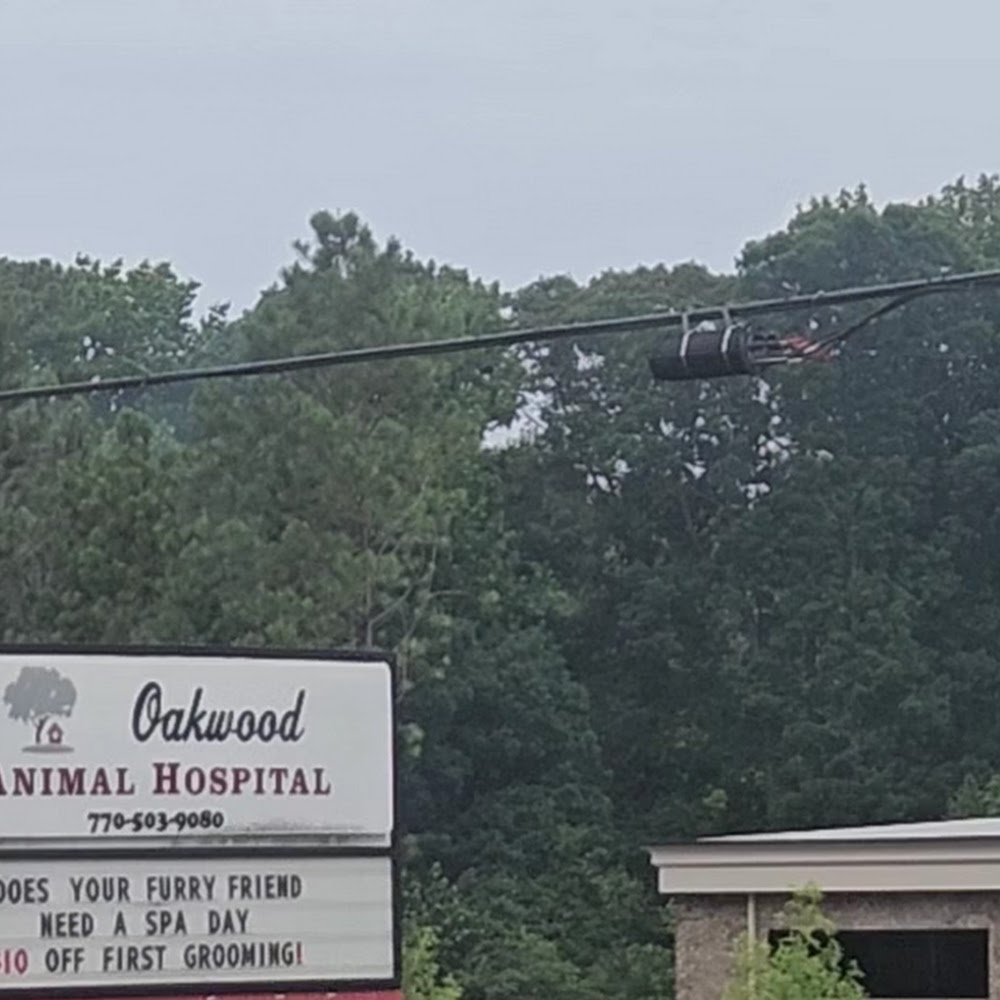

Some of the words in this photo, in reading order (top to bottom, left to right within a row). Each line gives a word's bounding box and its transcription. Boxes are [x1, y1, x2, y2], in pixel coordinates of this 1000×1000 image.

[131, 681, 306, 743] Oakwood
[152, 762, 331, 796] HOSPITAL
[87, 811, 224, 833] 770-503-9080
[70, 876, 131, 903] YOUR
[146, 875, 217, 902] FURRY
[228, 874, 303, 900] FRIEND
[40, 913, 94, 938] NEED
[114, 912, 127, 936] A
[146, 911, 187, 936] SPA
[208, 909, 250, 934] DAY
[45, 947, 86, 973] OFF
[103, 945, 167, 971] FIRST
[184, 941, 303, 969] GROOMING!
